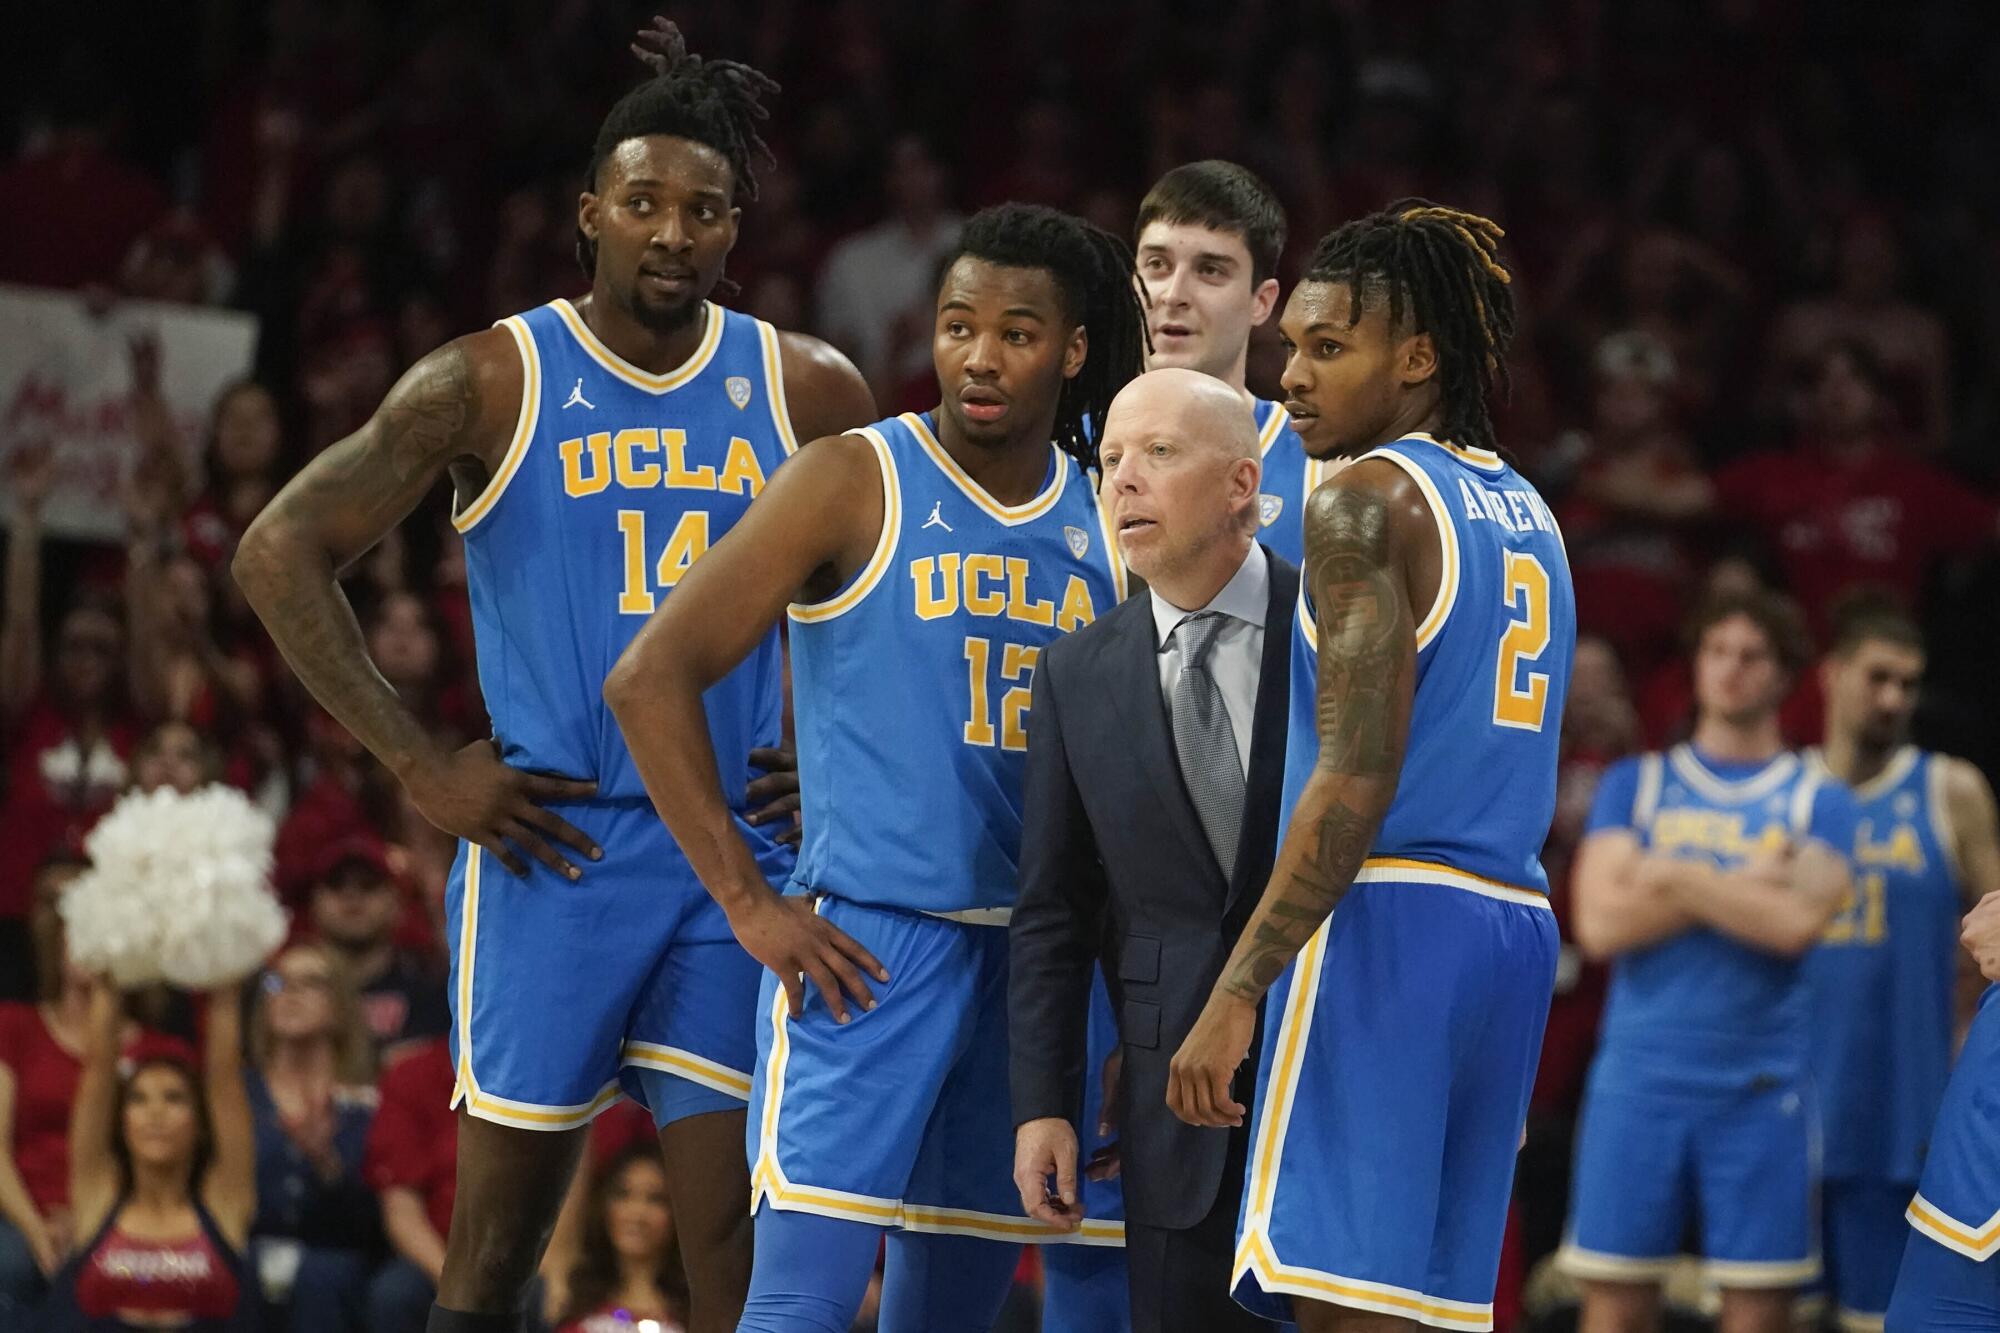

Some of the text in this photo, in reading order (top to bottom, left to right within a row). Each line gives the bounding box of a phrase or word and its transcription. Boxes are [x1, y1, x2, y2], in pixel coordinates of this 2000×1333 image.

[559, 427, 767, 499] UCLA
[617, 509, 710, 614] 14
[910, 552, 1096, 633] UCLA
[1493, 547, 1550, 732] 2
[964, 636, 1042, 752] 12
